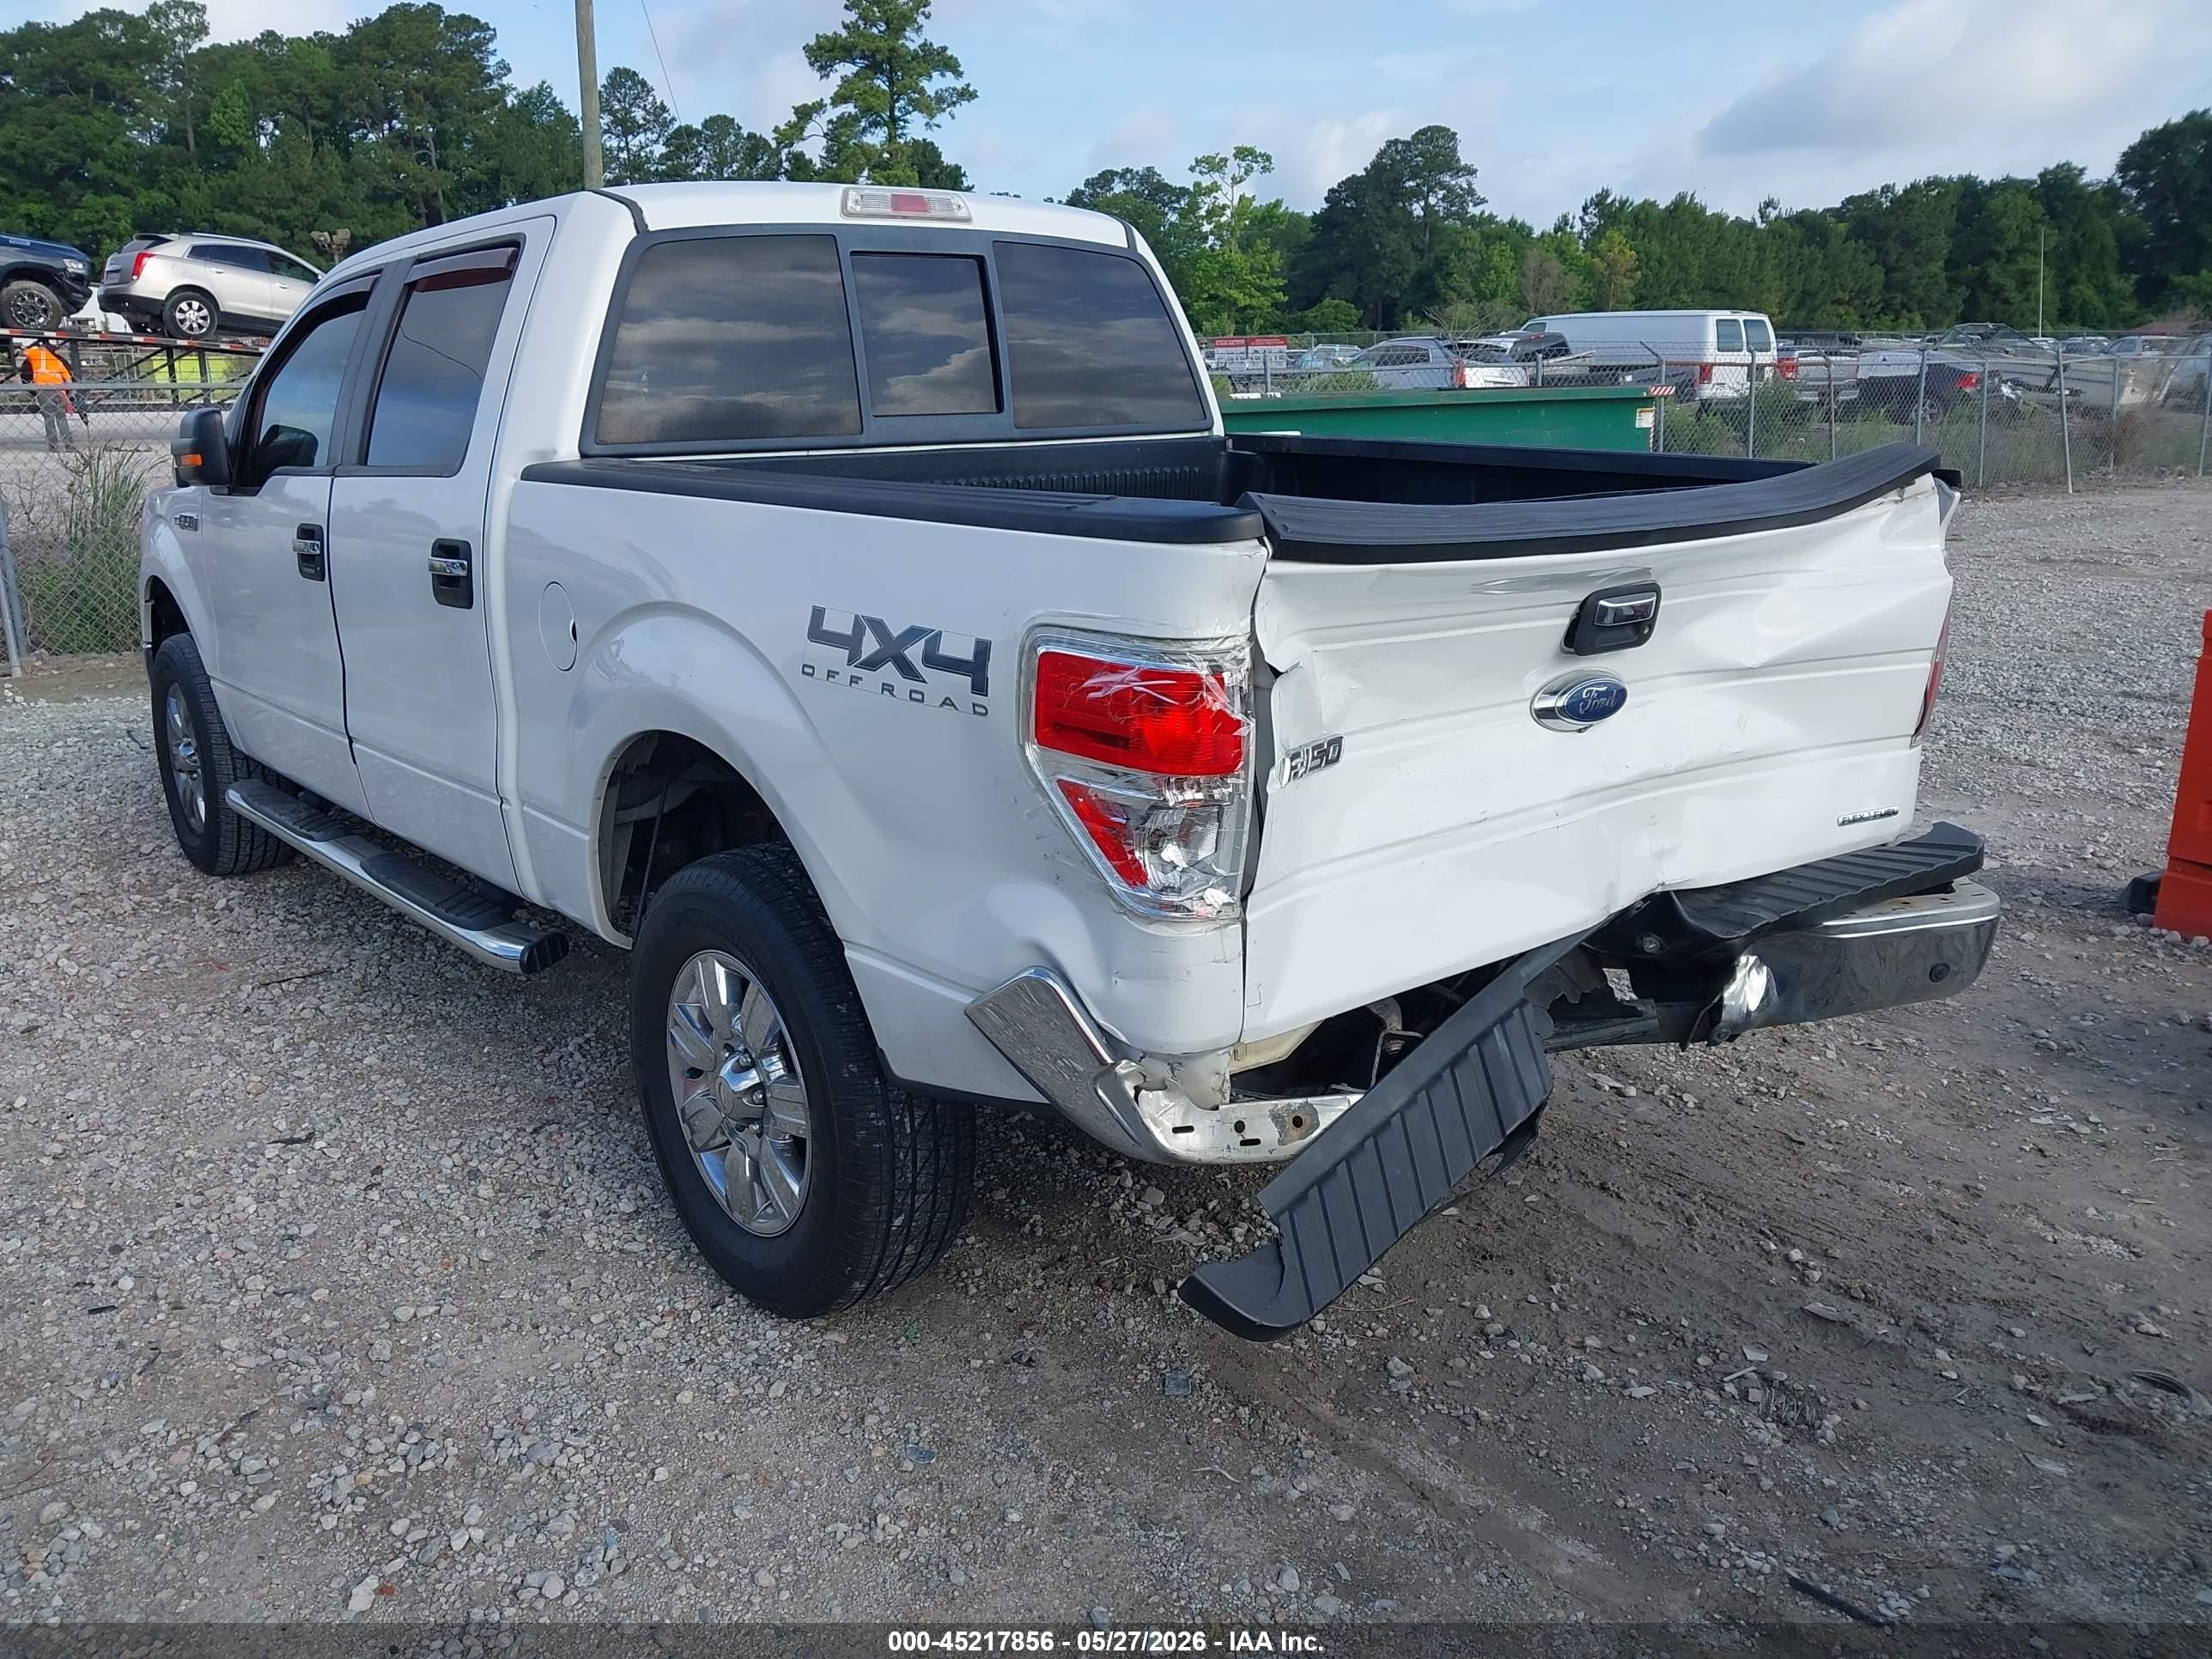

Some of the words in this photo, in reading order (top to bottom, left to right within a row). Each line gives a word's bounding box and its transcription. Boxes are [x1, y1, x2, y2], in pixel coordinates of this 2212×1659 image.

[1579, 685, 1618, 714] Ford
[1841, 813, 1866, 824] FLEX
[1873, 807, 1899, 818] FUEL
